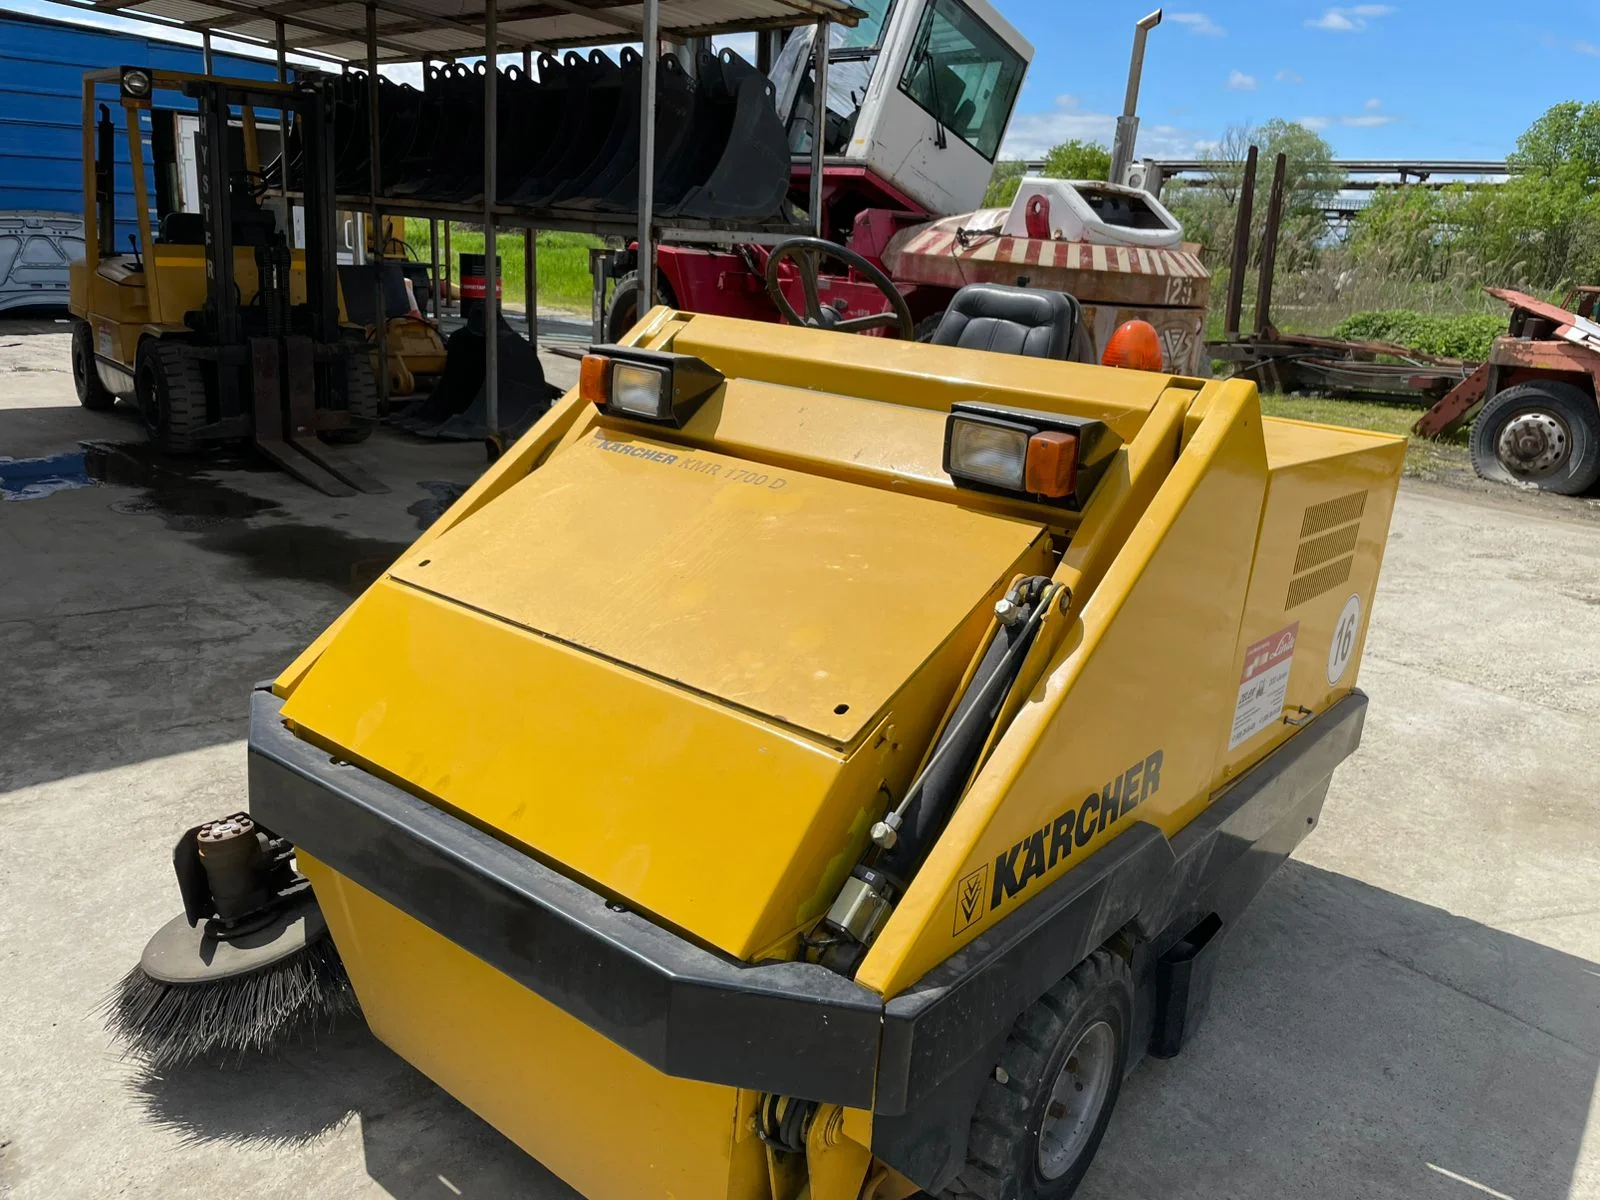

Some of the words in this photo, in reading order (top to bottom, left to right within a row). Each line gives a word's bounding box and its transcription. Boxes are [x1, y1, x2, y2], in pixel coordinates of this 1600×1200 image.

[679, 458, 721, 476] KMR
[724, 468, 767, 487] 1700
[768, 478, 787, 490] D
[1334, 613, 1355, 666] 16
[990, 750, 1164, 911] KÄRCHER
